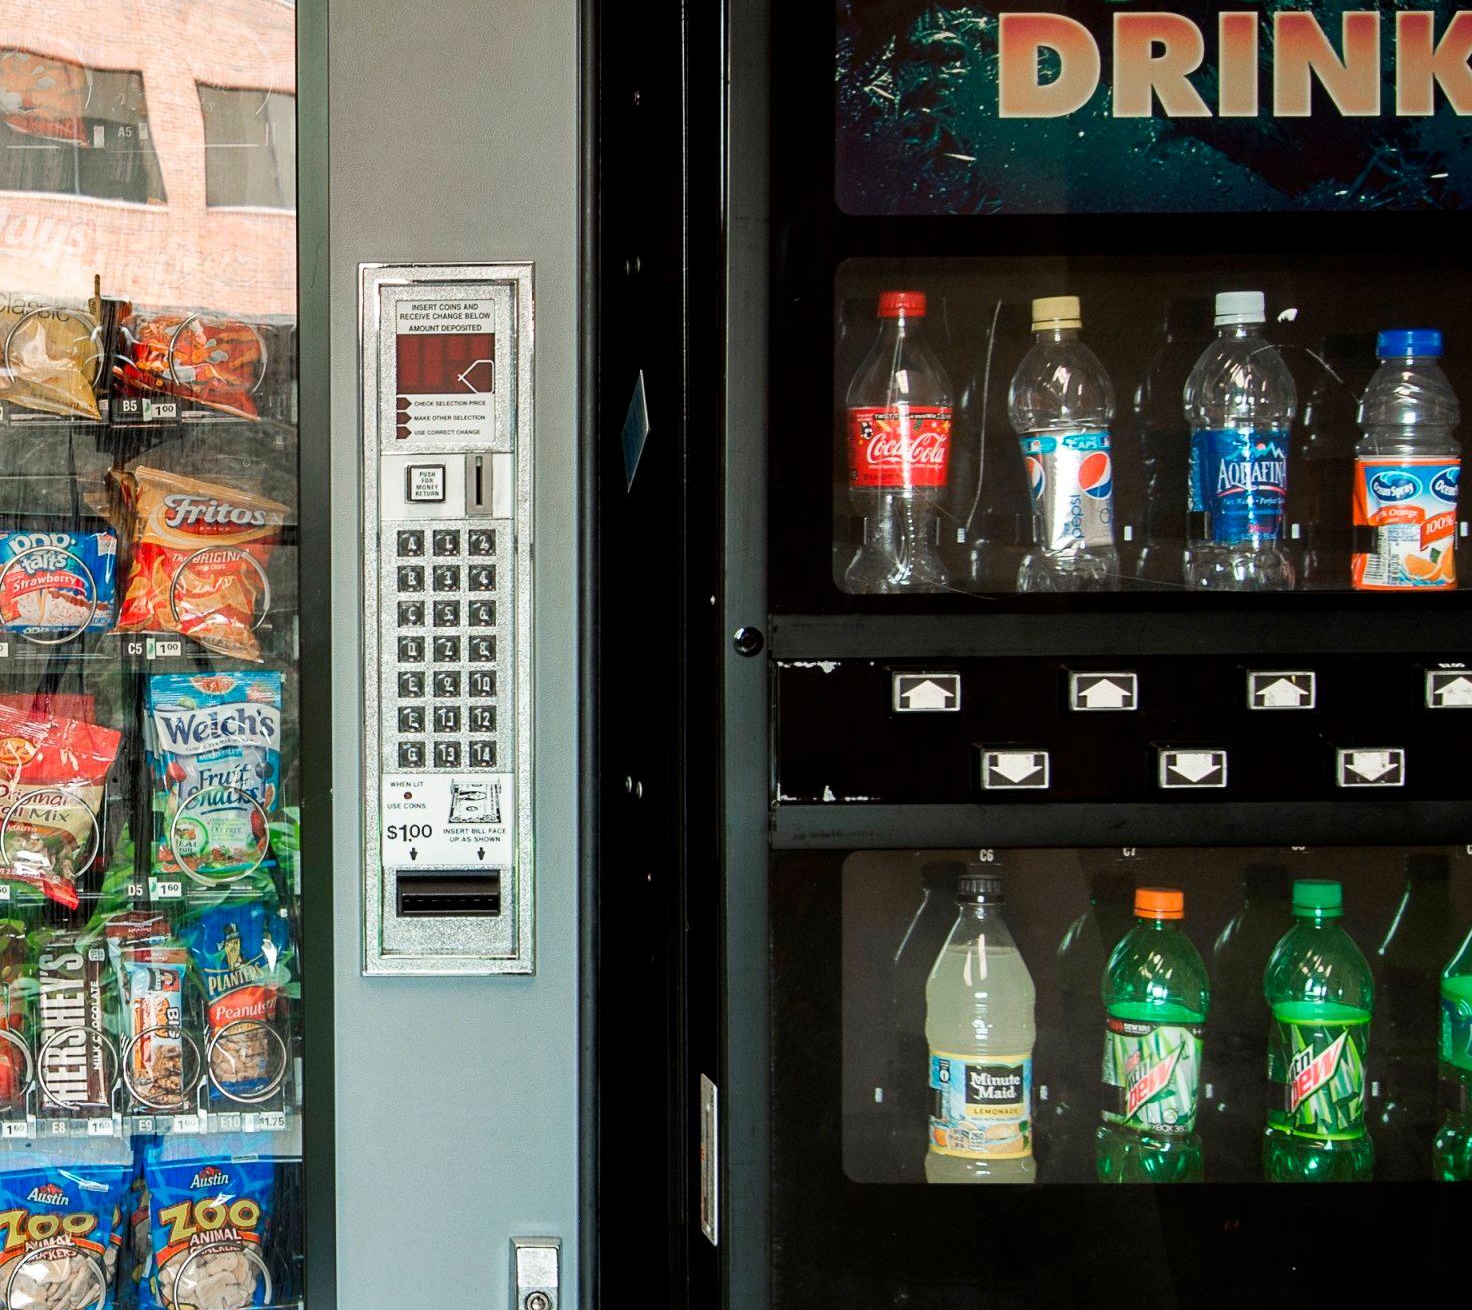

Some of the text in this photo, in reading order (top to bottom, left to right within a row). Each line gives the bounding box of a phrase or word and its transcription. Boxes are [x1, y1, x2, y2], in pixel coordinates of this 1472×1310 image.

[118, 127, 132, 138] A5
[400, 312, 491, 320] RECEIVE CHANGE BELOW
[409, 324, 482, 332] AMOUNT DEPOSITED
[123, 400, 137, 412] B5
[1391, 482, 1414, 498] Spray
[163, 494, 267, 528] Fritos
[1071, 495, 1085, 539] pepsi
[1426, 514, 1455, 535] 100%
[13, 573, 76, 592] Strawberry
[128, 643, 142, 655] C5
[161, 708, 275, 744] Welch's
[200, 763, 250, 788] Fruit
[387, 824, 432, 842] $1.00
[980, 850, 994, 862] C6
[128, 886, 142, 896] D5
[209, 964, 265, 995] PLANTERS
[40, 953, 88, 1102] HERSHEY'S
[969, 1072, 1021, 1086] Minute
[977, 1086, 1017, 1099] Maid
[52, 1122, 65, 1134] E8
[139, 1120, 152, 1131] E9
[260, 1117, 284, 1127] $1.75
[190, 1172, 230, 1189] Austin
[27, 1188, 70, 1206] Austin
[161, 1197, 261, 1244] ZOO
[190, 1228, 242, 1245] ANIMAL
